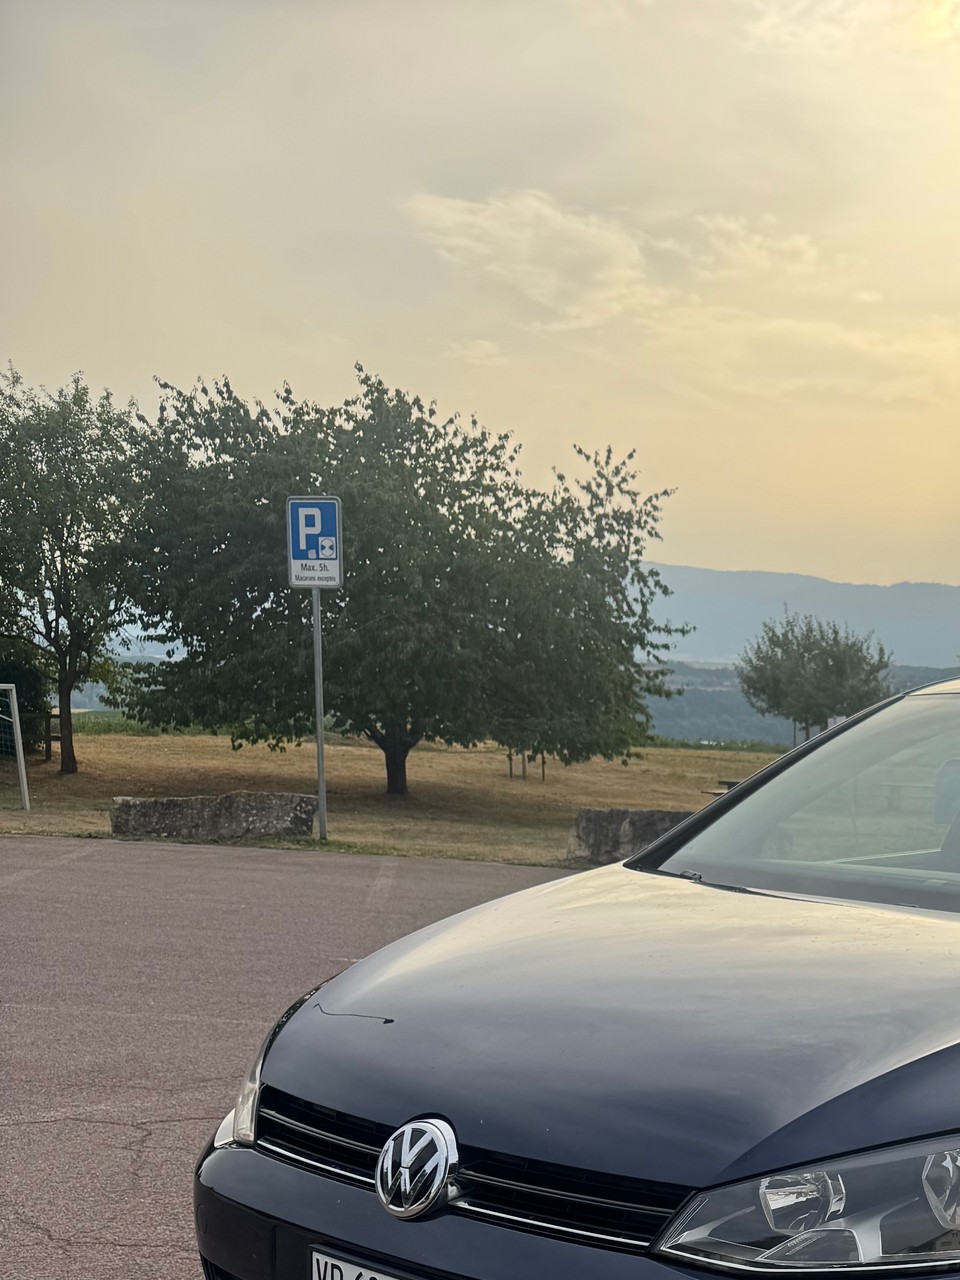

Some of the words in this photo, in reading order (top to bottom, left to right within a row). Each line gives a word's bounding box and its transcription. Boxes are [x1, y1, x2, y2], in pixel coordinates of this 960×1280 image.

[298, 507, 322, 550] P
[301, 563, 317, 572] Max.
[378, 1121, 446, 1215] VW
